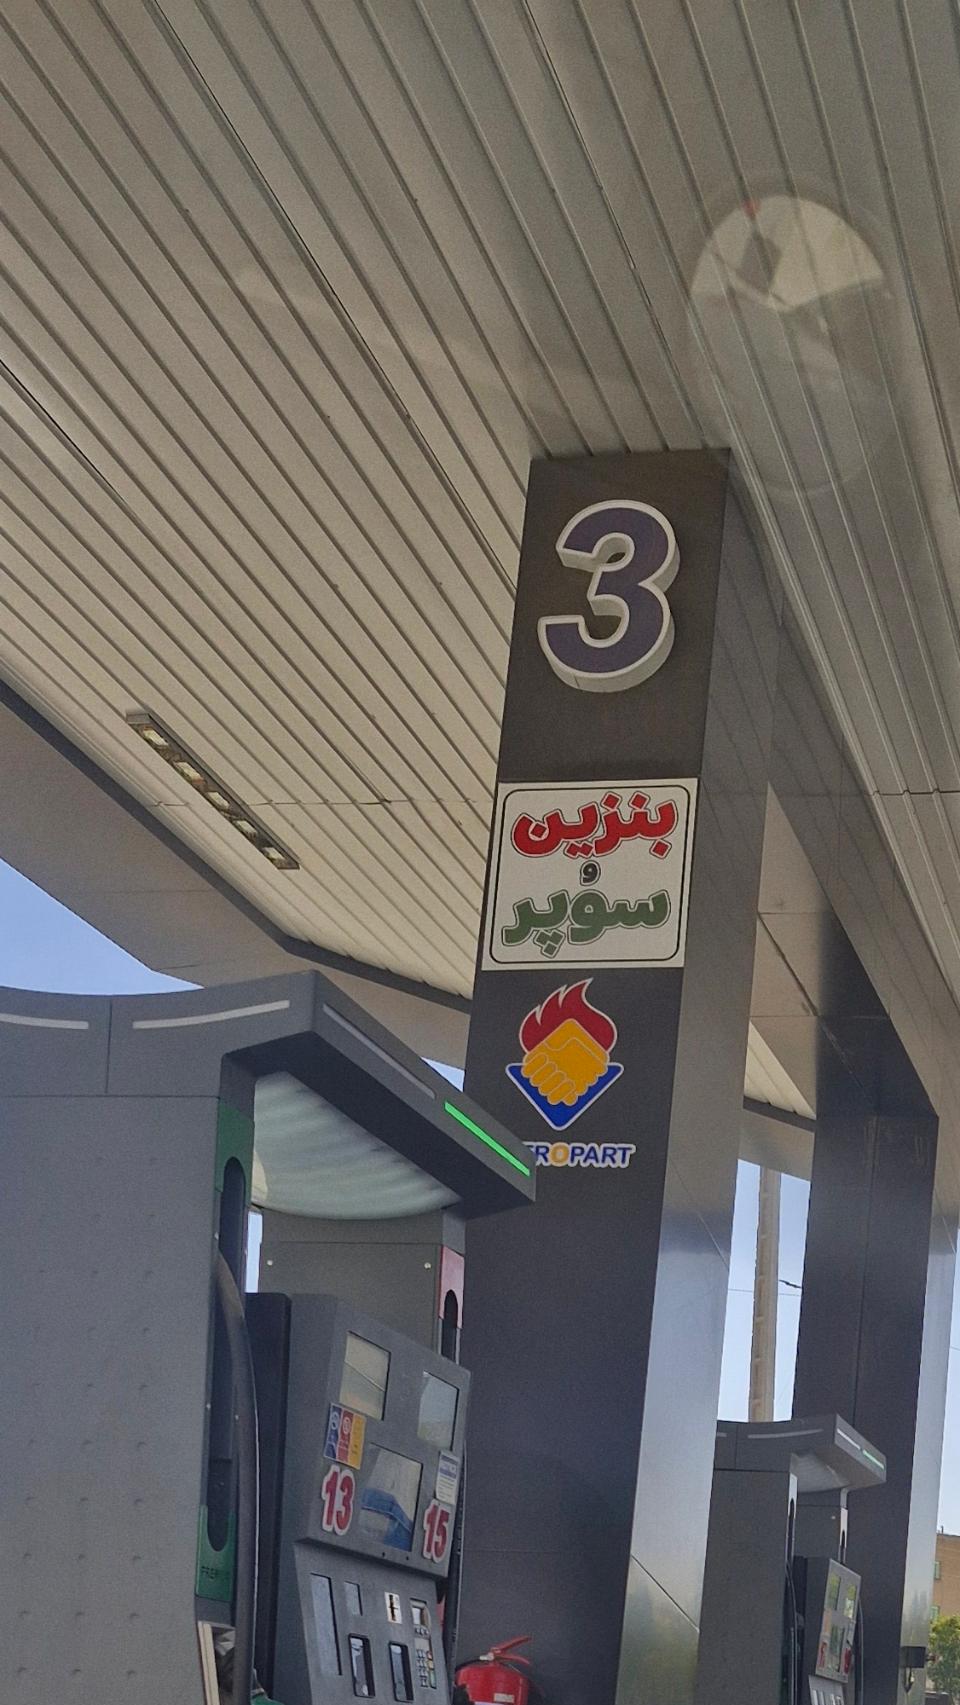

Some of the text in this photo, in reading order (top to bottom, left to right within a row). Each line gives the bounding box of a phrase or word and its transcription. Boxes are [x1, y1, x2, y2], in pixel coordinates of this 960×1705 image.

[537, 499, 681, 692] 3
[512, 791, 679, 859] بنزین
[580, 861, 600, 884] و
[501, 888, 671, 958] سوپر
[523, 1142, 636, 1168] ROPART
[323, 1466, 355, 1534] 13
[424, 1501, 450, 1560] 15
